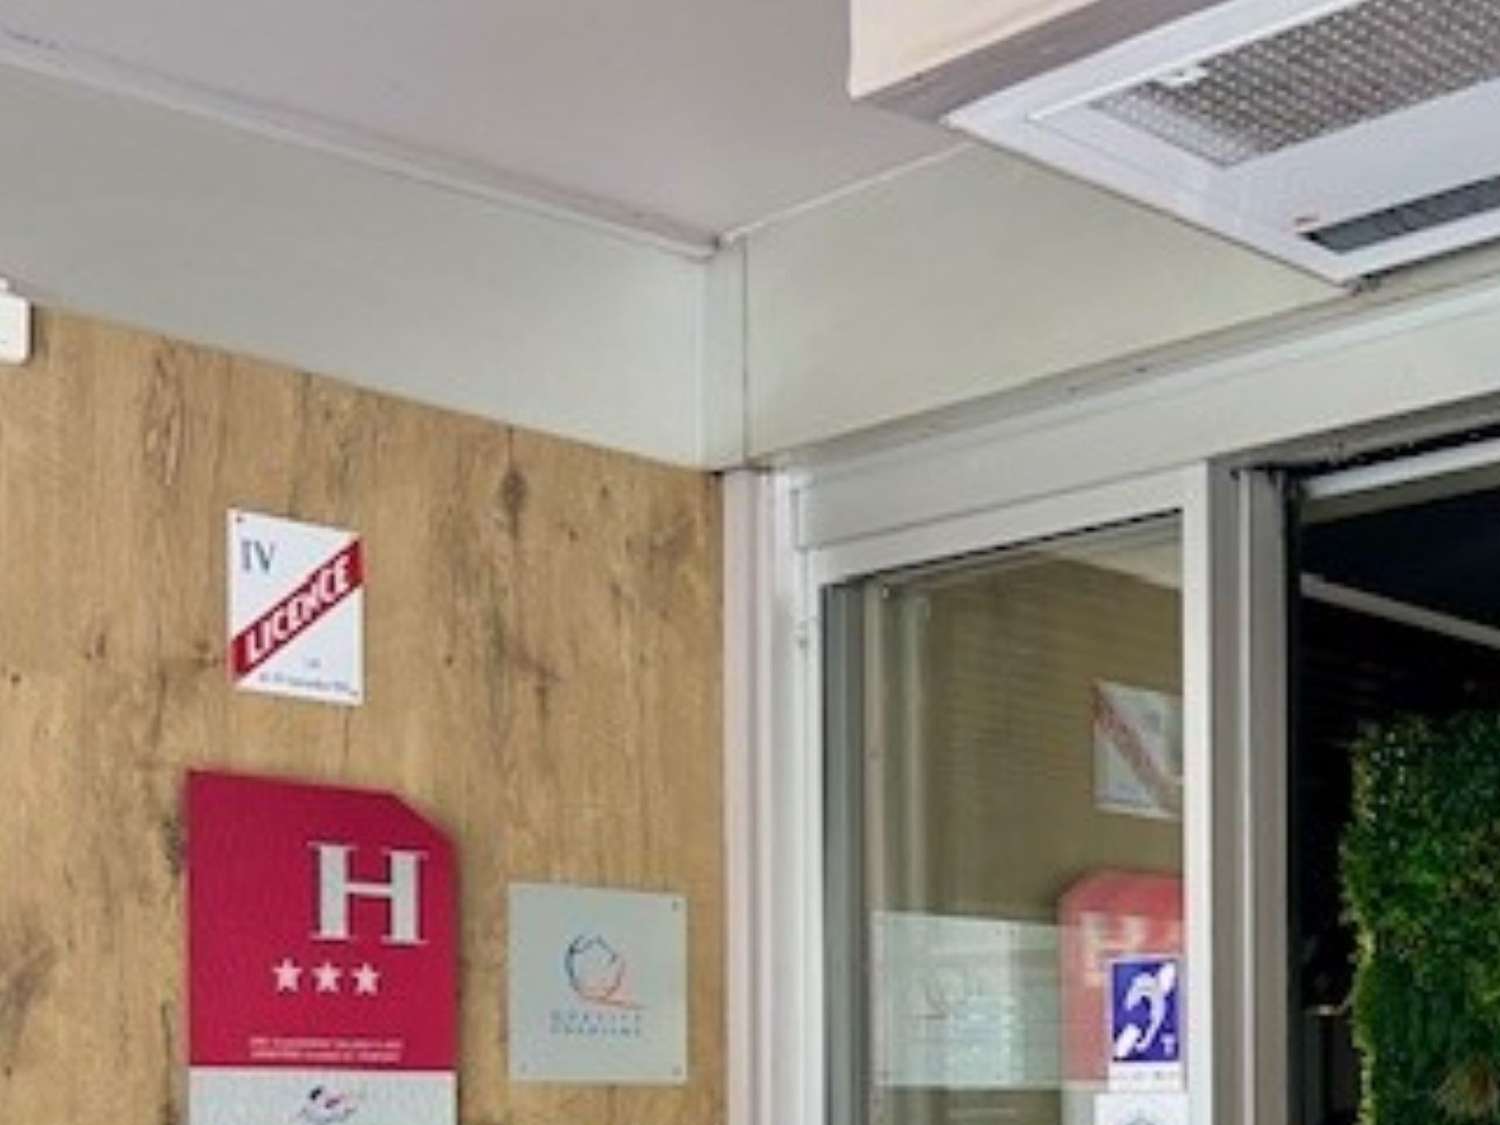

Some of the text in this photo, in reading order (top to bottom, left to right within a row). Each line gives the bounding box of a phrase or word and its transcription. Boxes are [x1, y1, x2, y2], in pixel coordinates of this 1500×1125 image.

[240, 539, 274, 573] IV
[244, 553, 352, 662] LICENCE
[309, 842, 428, 945] H
